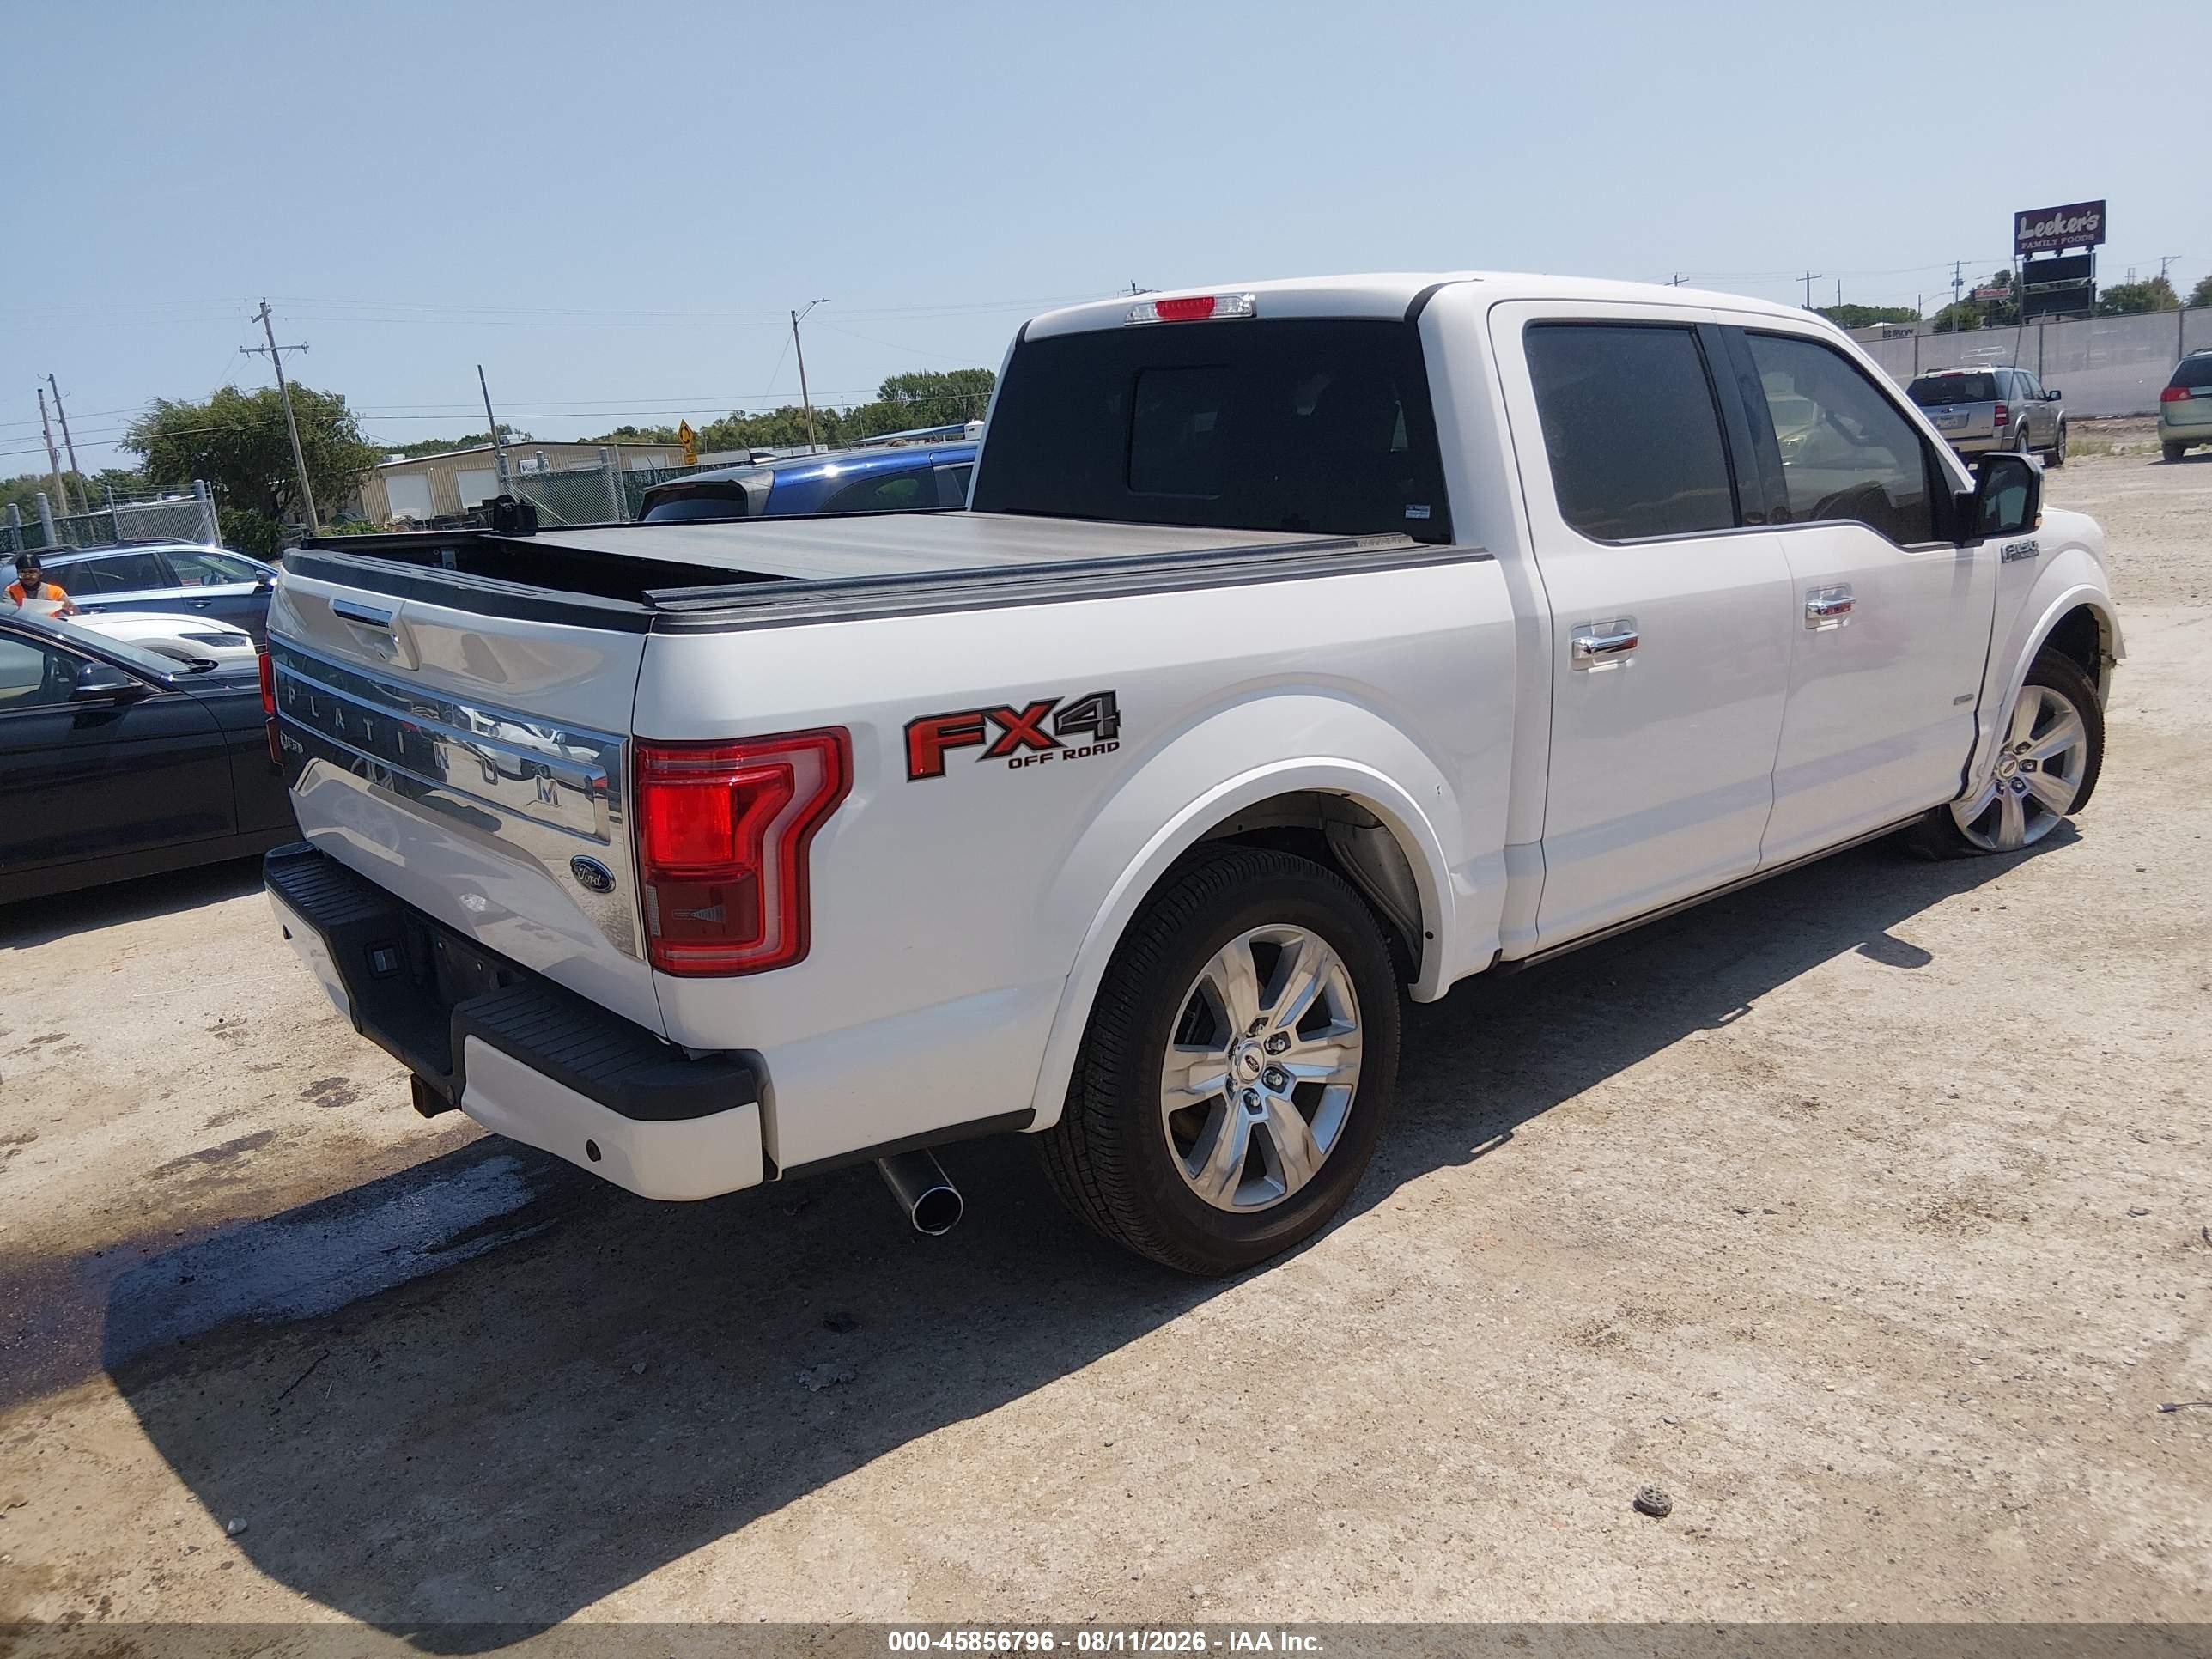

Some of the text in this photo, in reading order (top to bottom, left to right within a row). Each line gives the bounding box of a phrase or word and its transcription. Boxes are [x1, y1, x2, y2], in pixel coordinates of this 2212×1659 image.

[2017, 210, 2100, 240] Leeker's
[2021, 234, 2095, 250] FAMILY FOODS
[288, 686, 562, 805] PLATINUM
[902, 690, 1121, 783] FX4
[1008, 741, 1121, 769] OFF ROAD
[578, 863, 603, 887] Ford
